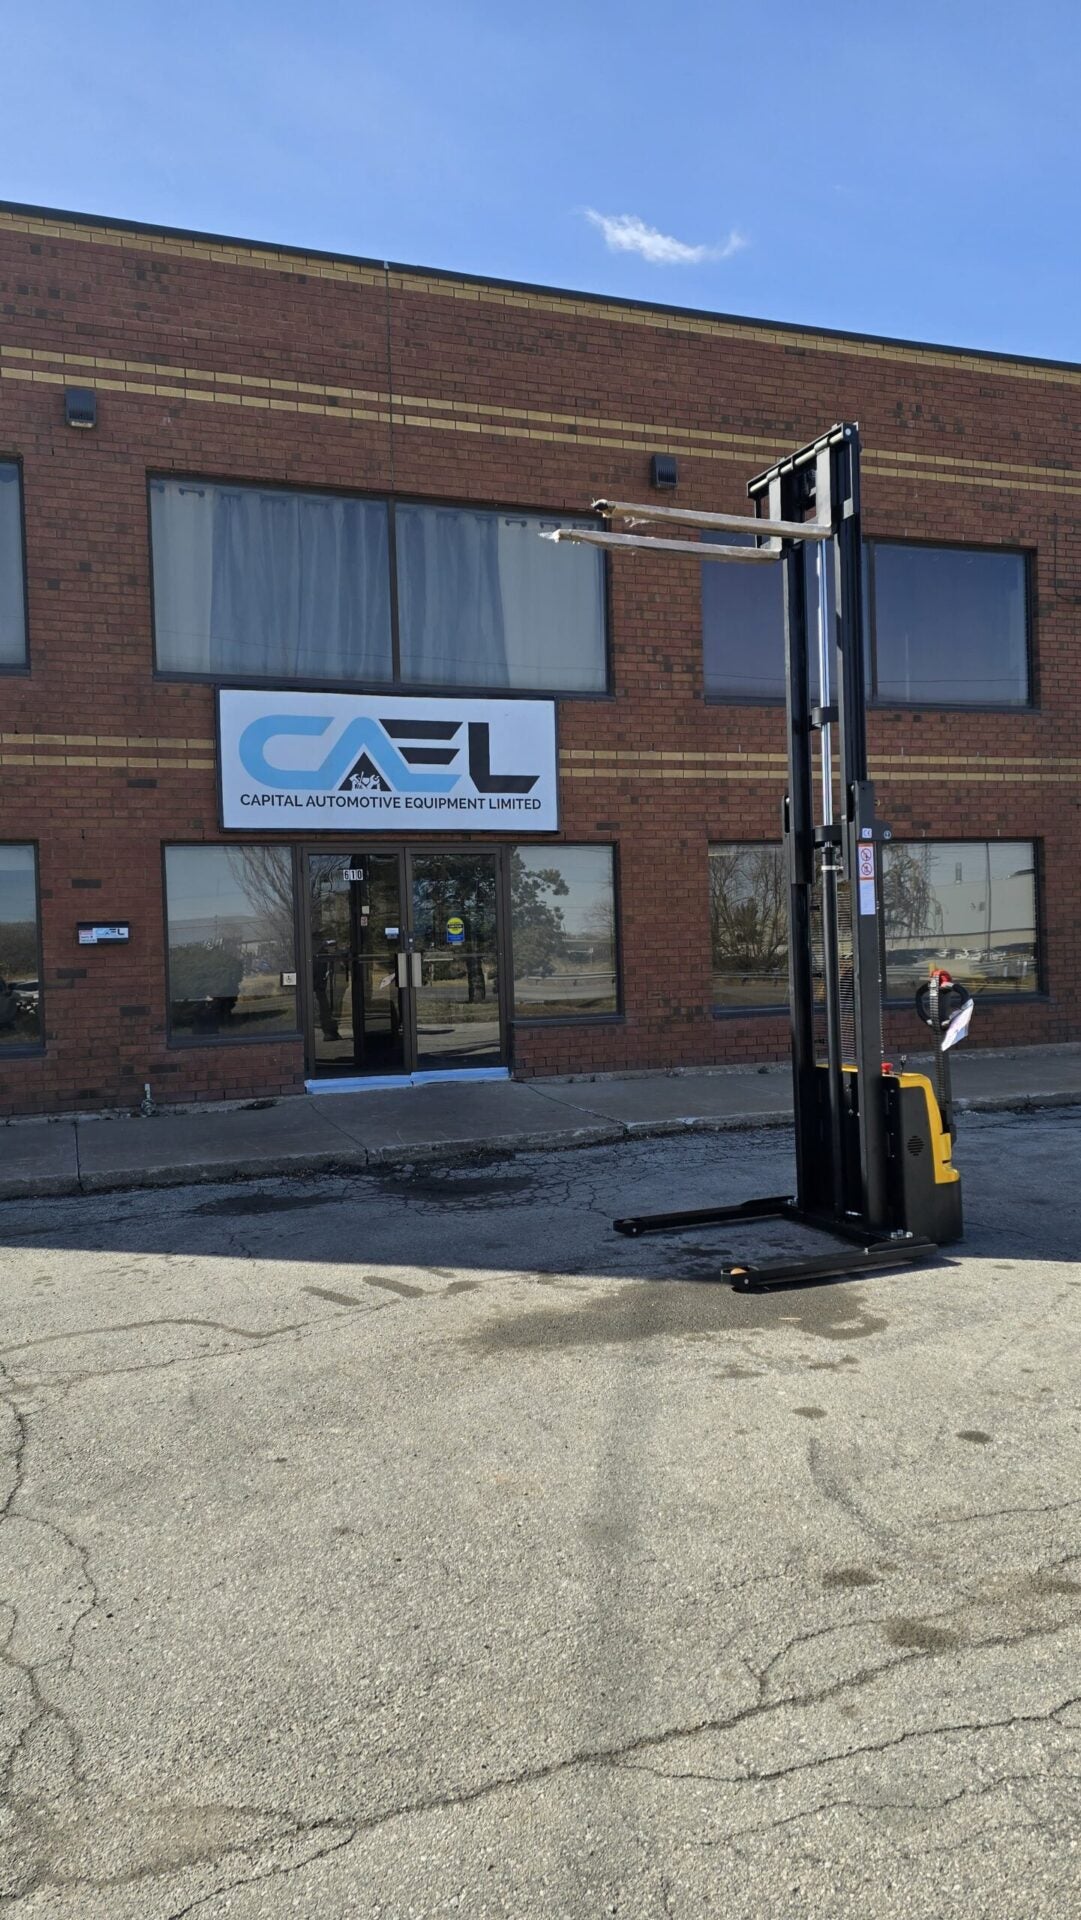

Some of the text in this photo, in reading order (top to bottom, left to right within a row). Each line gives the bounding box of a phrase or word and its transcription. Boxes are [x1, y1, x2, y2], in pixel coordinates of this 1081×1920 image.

[239, 714, 541, 794] CAEL
[240, 794, 541, 810] CAPITAL AUTOMOTIVE EQUIPMENT LIMITED
[344, 870, 363, 880] 610
